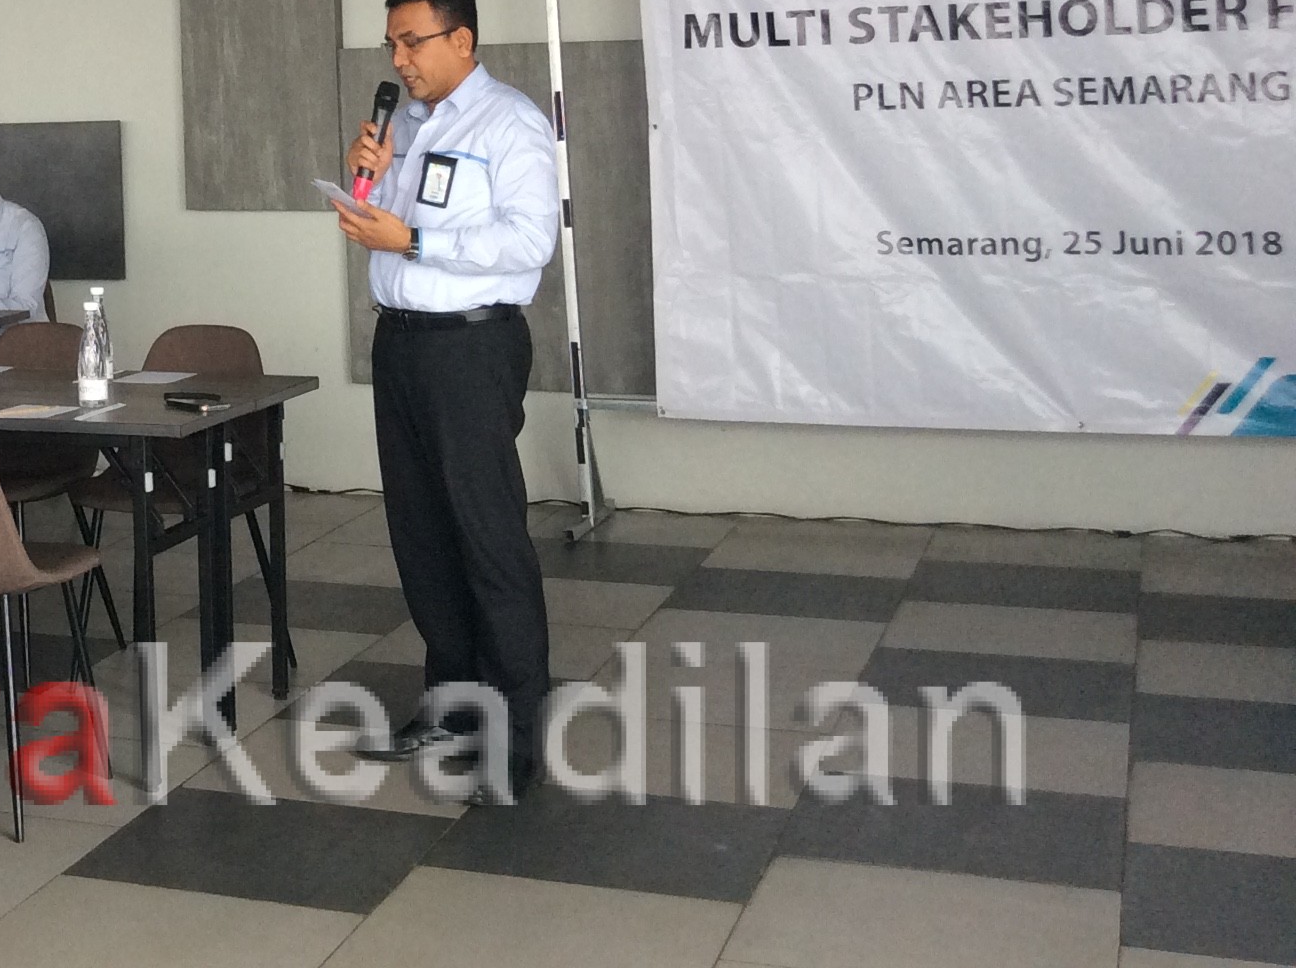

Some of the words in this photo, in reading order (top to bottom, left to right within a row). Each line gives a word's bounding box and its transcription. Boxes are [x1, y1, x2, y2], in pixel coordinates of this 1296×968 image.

[684, 8, 832, 49] MULTI
[853, 81, 925, 111] PLN
[938, 78, 1042, 109] AREA
[1054, 71, 1291, 106] SEMARANG
[876, 230, 1052, 263] Semarang,
[1063, 231, 1103, 256] 25
[1112, 230, 1184, 256] Juni
[1195, 230, 1283, 256] 2018
